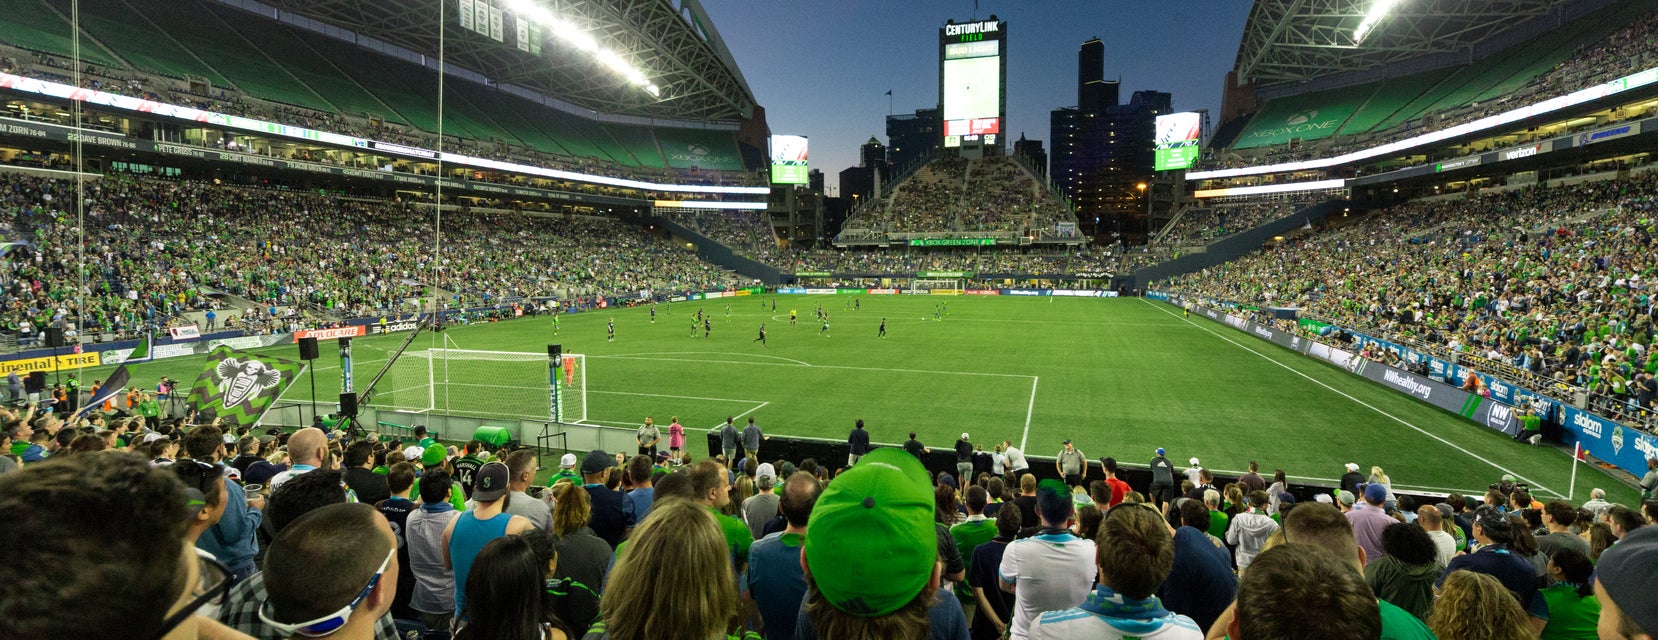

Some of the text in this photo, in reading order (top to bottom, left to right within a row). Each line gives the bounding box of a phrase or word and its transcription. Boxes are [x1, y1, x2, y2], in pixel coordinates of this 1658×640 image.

[949, 45, 994, 55] BUD LIGHT
[9, 126, 29, 136] ZORN
[1296, 120, 1337, 132] ONE
[1591, 126, 1630, 140] BOEING
[68, 133, 78, 141] 22
[80, 135, 96, 144] DAVE
[98, 137, 122, 146] BROWN
[159, 144, 172, 154] PETE
[173, 146, 192, 156] GROSS
[1506, 147, 1538, 161] verizon
[305, 326, 358, 338] ADVOCARE
[390, 322, 416, 332] adidas
[67, 355, 96, 366] TIRE
[1384, 369, 1431, 398] NWhealthy.org
[1492, 404, 1509, 420] NW
[1574, 412, 1602, 434] slalom
[456, 462, 477, 470] MARSHALL
[460, 469, 472, 485] 14
